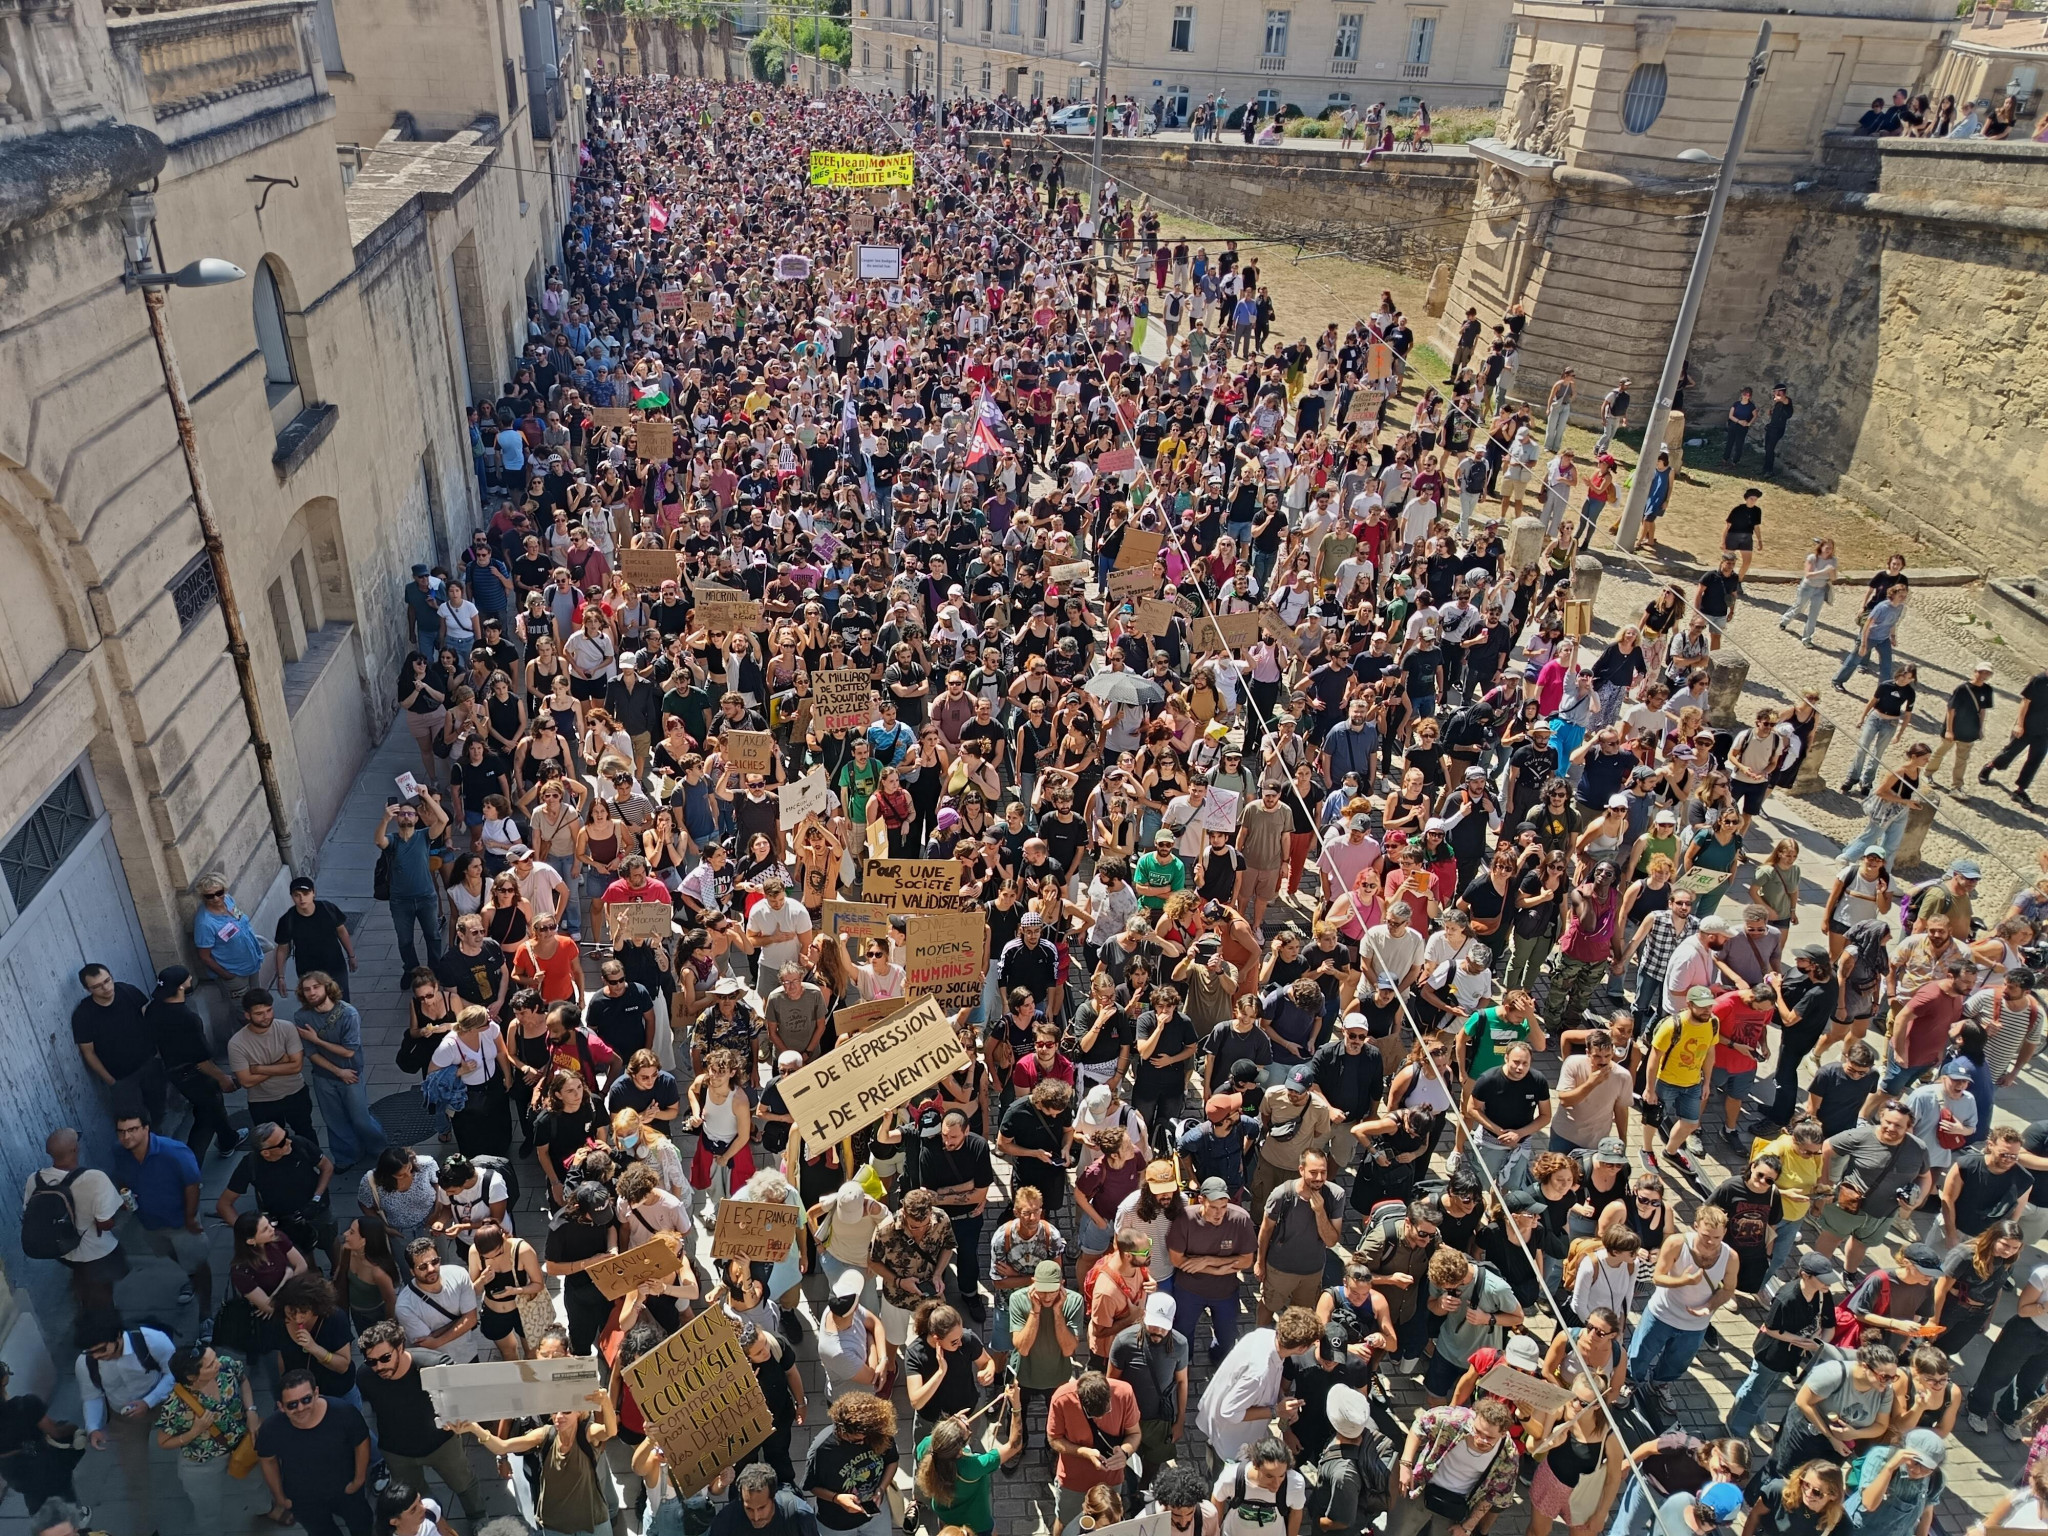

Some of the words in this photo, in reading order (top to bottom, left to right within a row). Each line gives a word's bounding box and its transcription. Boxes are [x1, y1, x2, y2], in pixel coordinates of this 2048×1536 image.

[840, 157, 865, 168] Jean
[869, 155, 914, 168] MONNET
[852, 171, 885, 184] LUTTE
[705, 590, 738, 602] MACRON
[820, 685, 833, 694] DE
[815, 694, 829, 705] LA
[830, 692, 870, 703] SOLUTION
[825, 712, 871, 729] RICHES
[742, 748, 758, 758] LES
[735, 759, 766, 770] RICHES
[866, 859, 902, 879] POUR
[909, 865, 946, 879] UNE
[929, 929, 957, 943] LES
[915, 941, 972, 958] MOYENS
[911, 962, 976, 984] HUMAINS
[908, 983, 943, 997] TIRED
[945, 980, 982, 994] SOCIAL
[953, 994, 981, 1009] CLUB
[814, 1064, 841, 1089] DE
[841, 1005, 938, 1073] RÉPRESSION
[828, 1101, 857, 1130] DE
[857, 1038, 963, 1113] PRÉVENTION
[723, 1204, 753, 1225] LES
[741, 1225, 765, 1237] SEC
[745, 1245, 766, 1257] DIT
[590, 1251, 648, 1281] MANU
[666, 1342, 715, 1383] pour
[658, 1370, 736, 1435] commence
[662, 1423, 690, 1451] par
[667, 1448, 694, 1468] les
